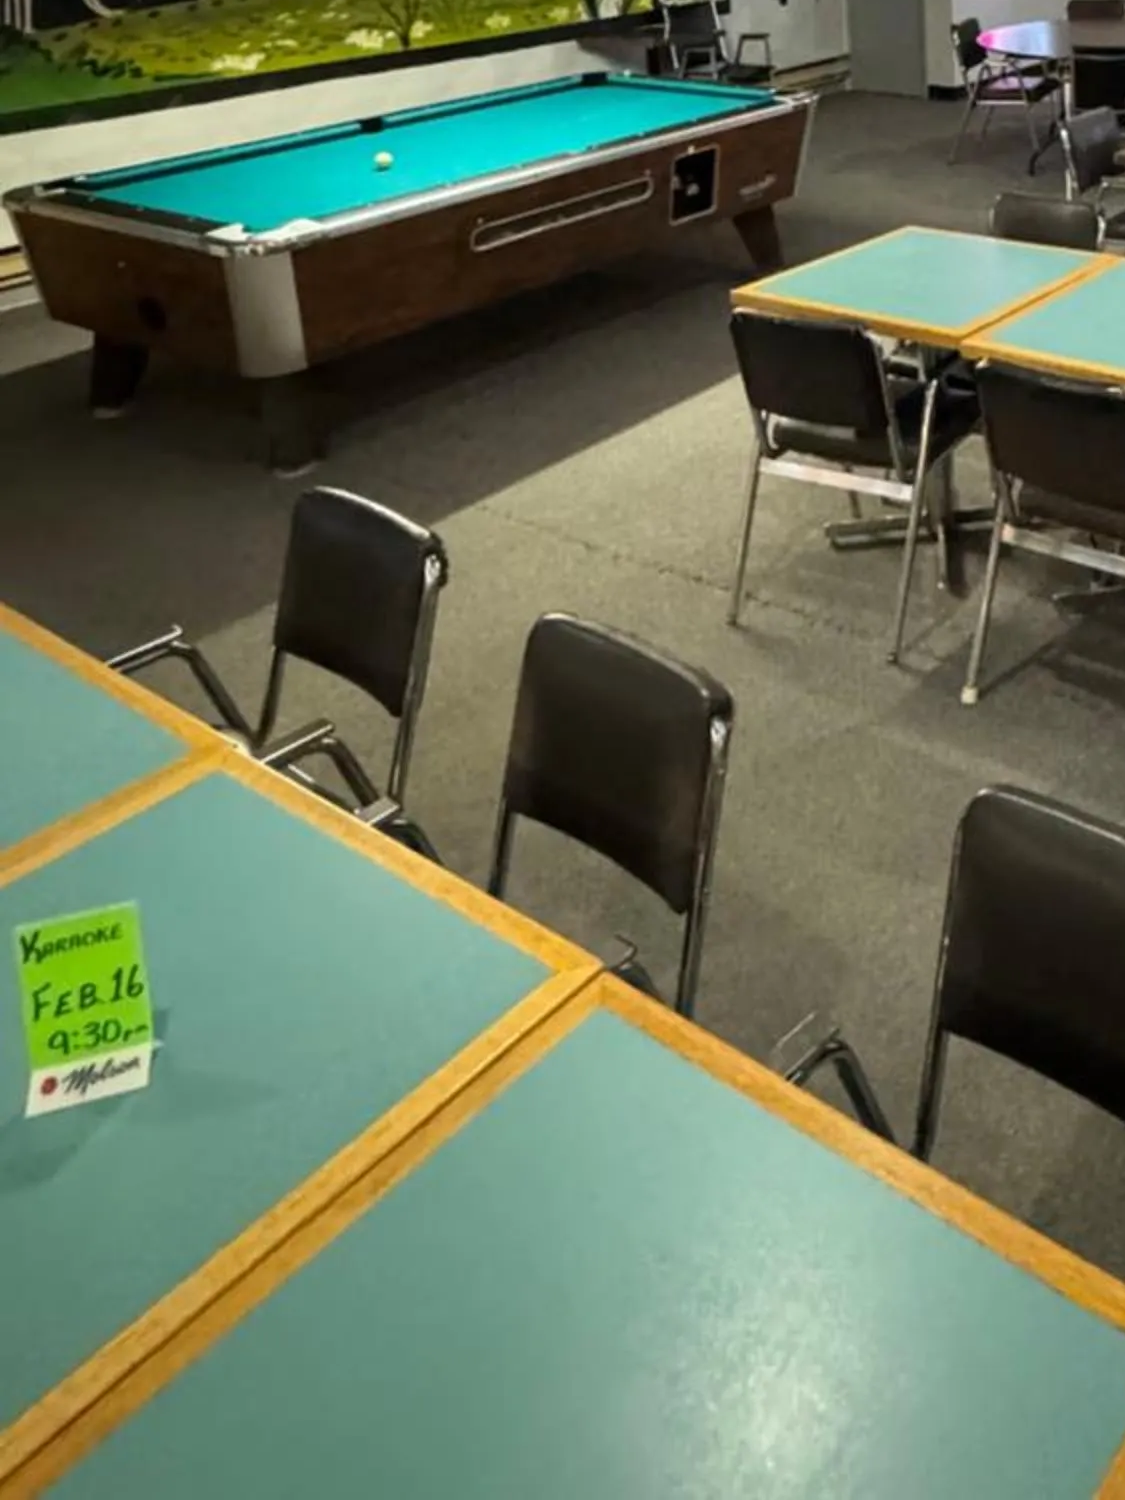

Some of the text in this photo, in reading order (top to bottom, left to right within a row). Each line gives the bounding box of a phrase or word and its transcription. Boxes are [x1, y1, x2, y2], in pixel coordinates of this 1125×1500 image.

[20, 923, 123, 965] KARAOKE
[110, 964, 145, 1002] 16
[61, 1056, 141, 1096] Molson
